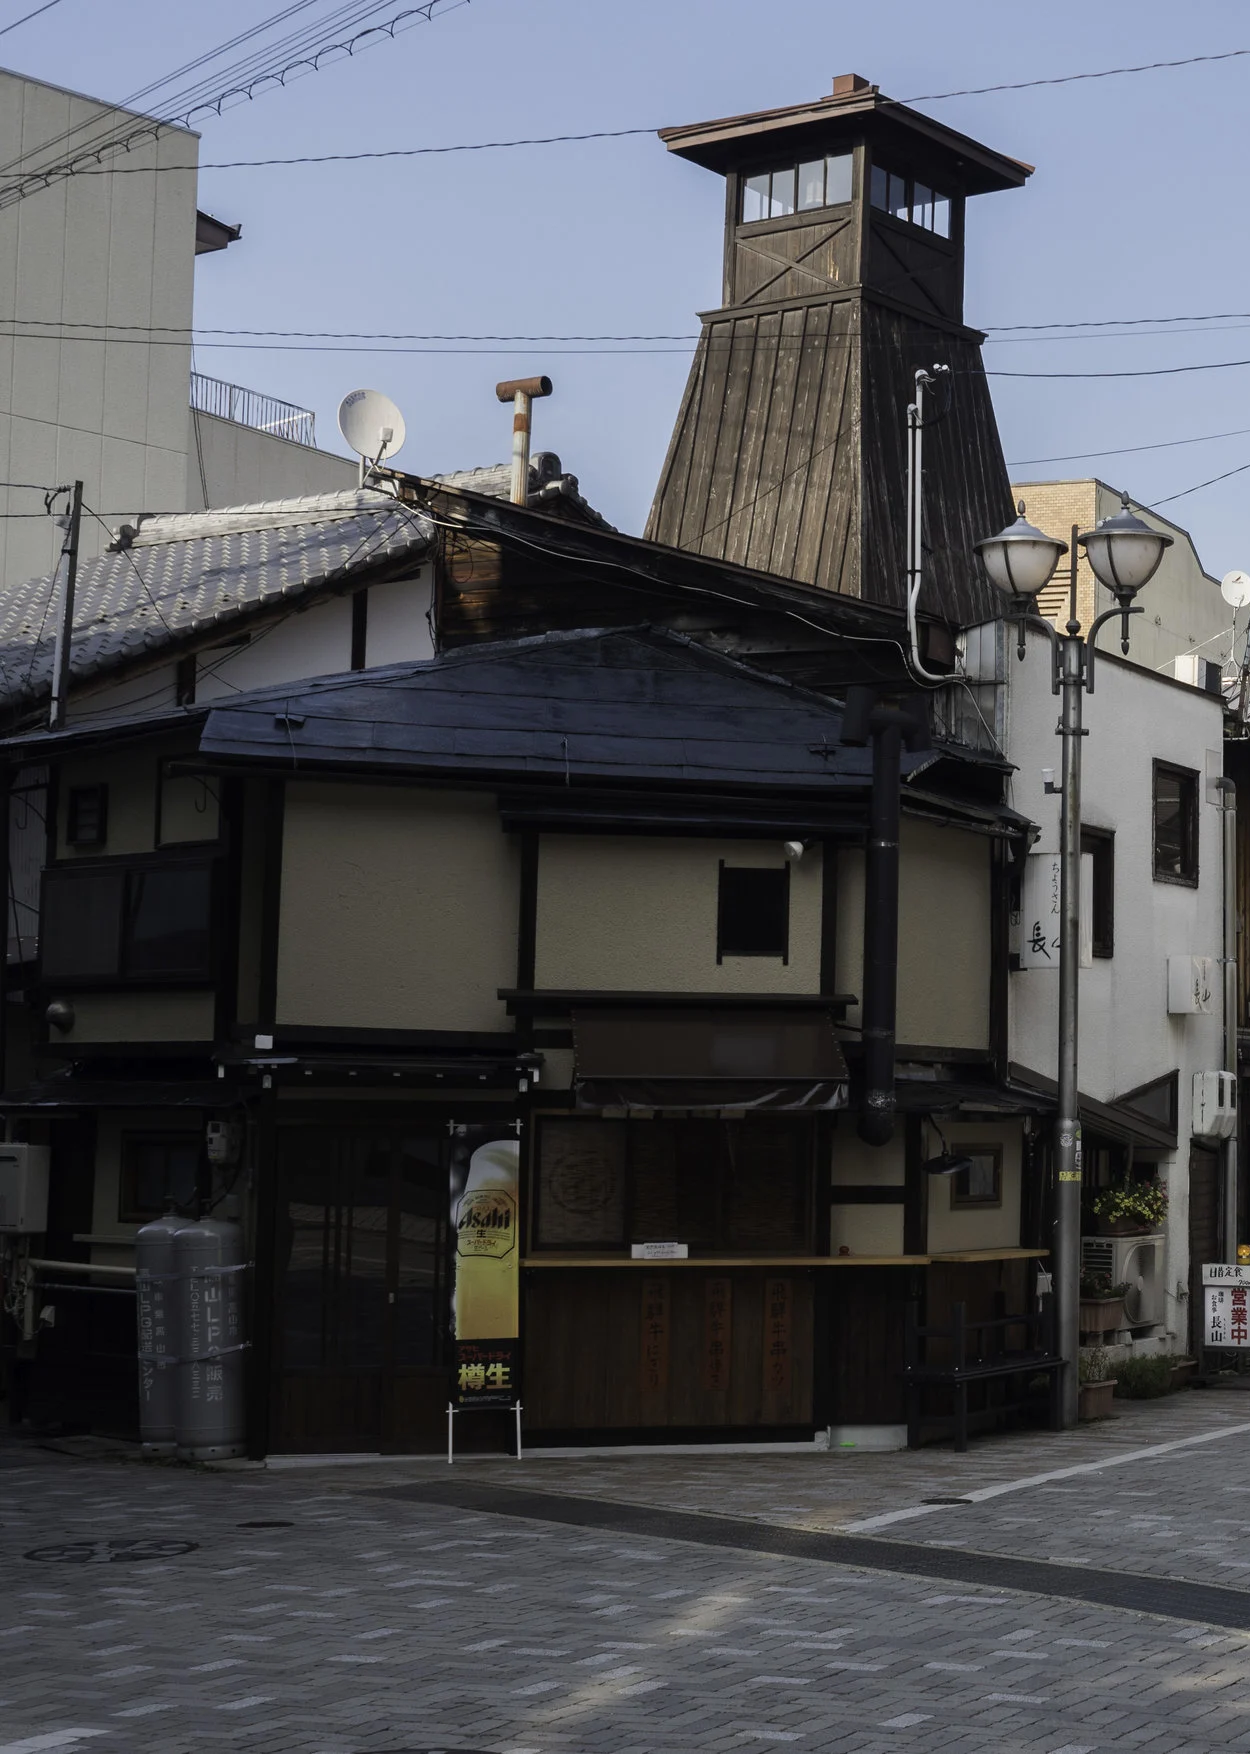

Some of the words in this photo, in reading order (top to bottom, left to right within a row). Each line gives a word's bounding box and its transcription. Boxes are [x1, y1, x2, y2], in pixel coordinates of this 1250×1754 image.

[458, 1207, 511, 1230] Asahi
[1211, 1316, 1222, 1342] 長山
[1231, 1288, 1248, 1345] 営業中
[458, 1362, 512, 1391] 樽生
